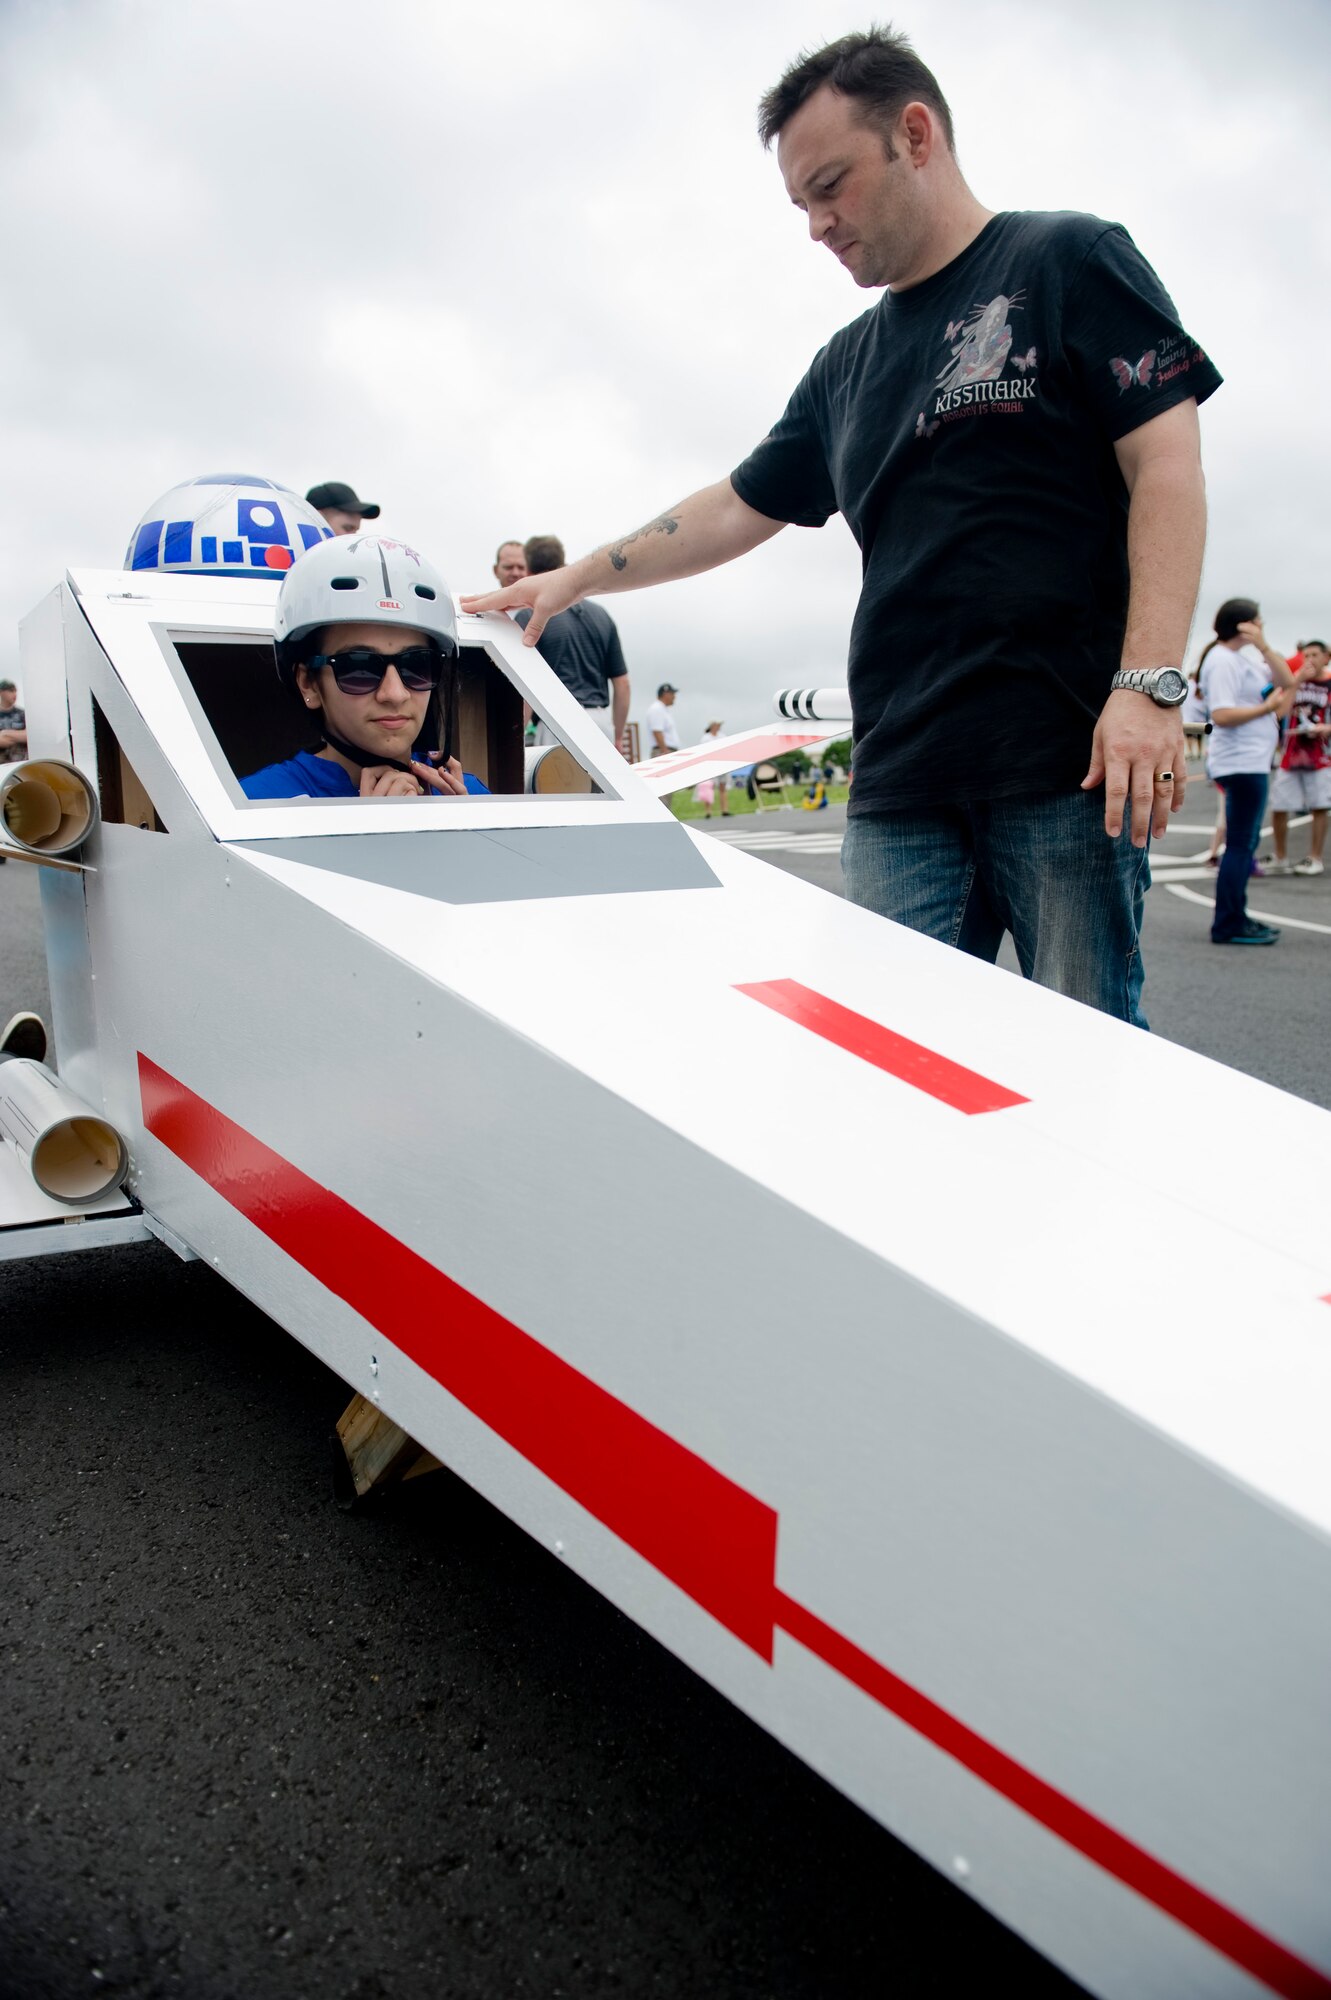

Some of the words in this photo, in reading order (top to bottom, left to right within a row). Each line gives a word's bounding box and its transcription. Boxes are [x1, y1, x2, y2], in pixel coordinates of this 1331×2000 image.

[934, 378, 1036, 414] KISSMARK
[942, 406, 977, 423] NOBODY
[978, 403, 989, 415] IS
[991, 401, 1024, 413] EQUAL
[380, 601, 401, 609] BELL
